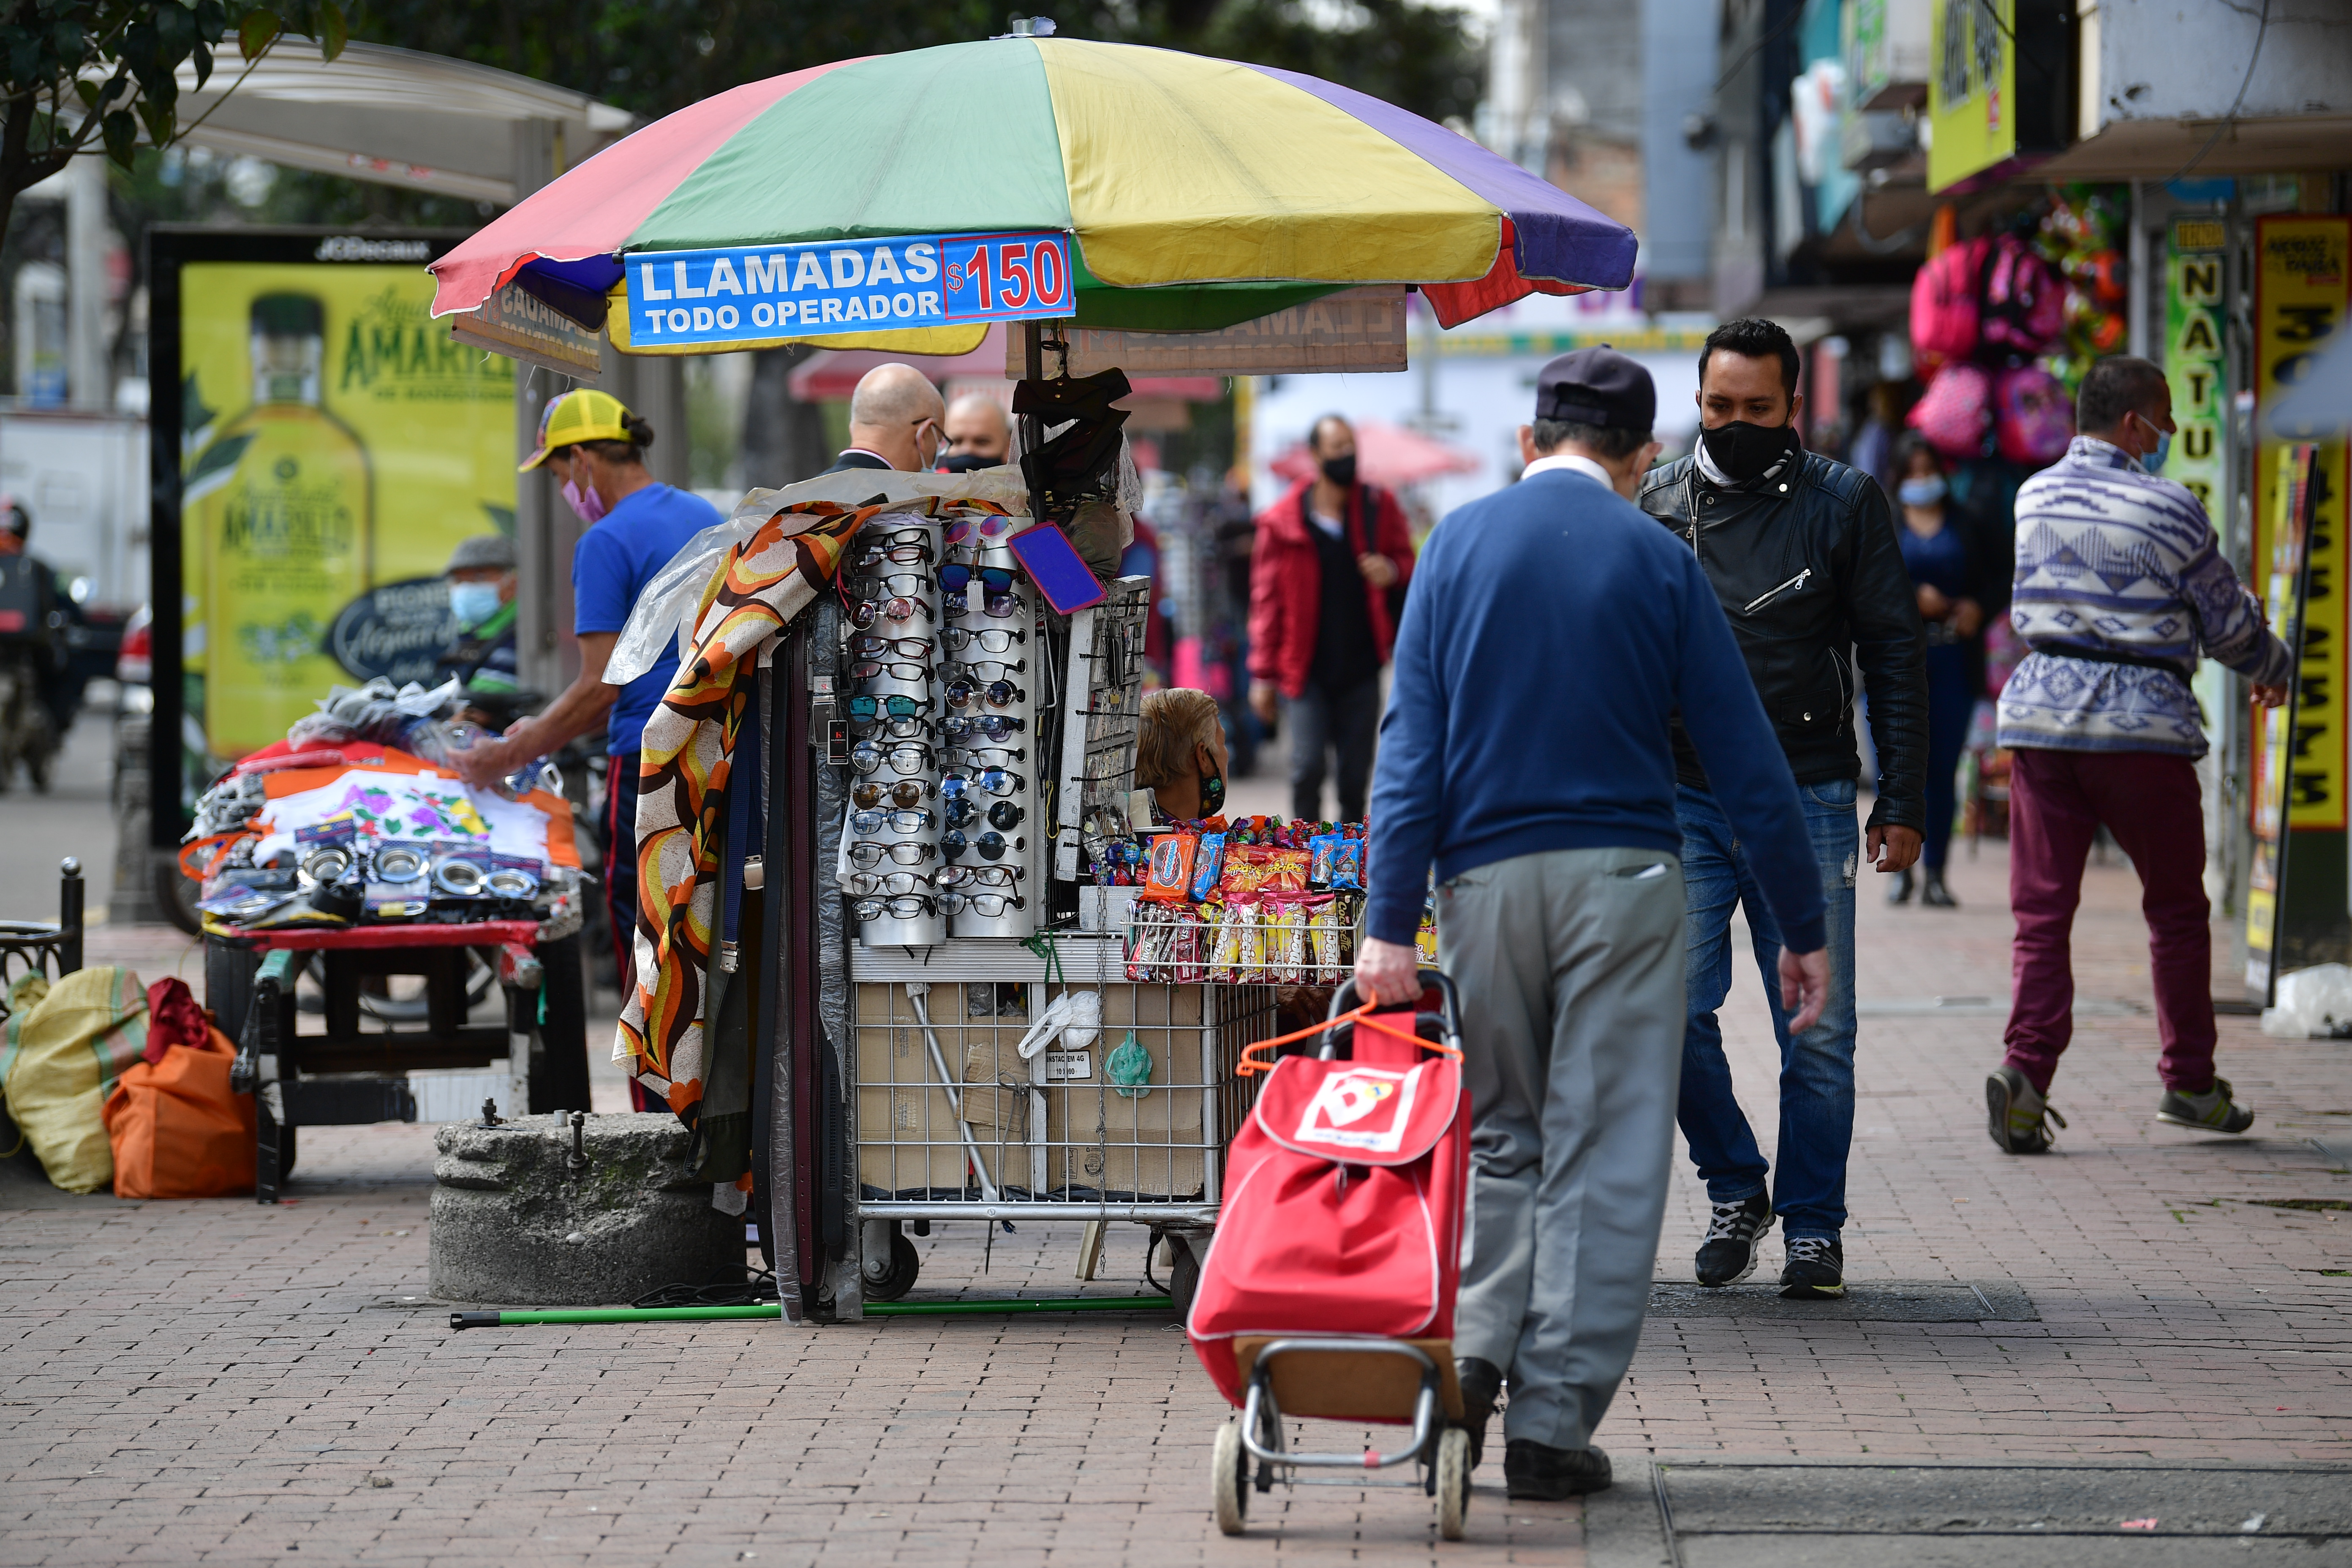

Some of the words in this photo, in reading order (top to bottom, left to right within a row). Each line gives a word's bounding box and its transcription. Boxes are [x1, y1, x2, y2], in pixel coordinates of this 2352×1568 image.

[641, 242, 939, 301] LLAMADAS
[645, 309, 740, 334] TODO
[752, 291, 941, 327] OPERADOR
[1165, 841, 1176, 877] CHOCORAMO
[1136, 941, 1154, 977] Fetival
